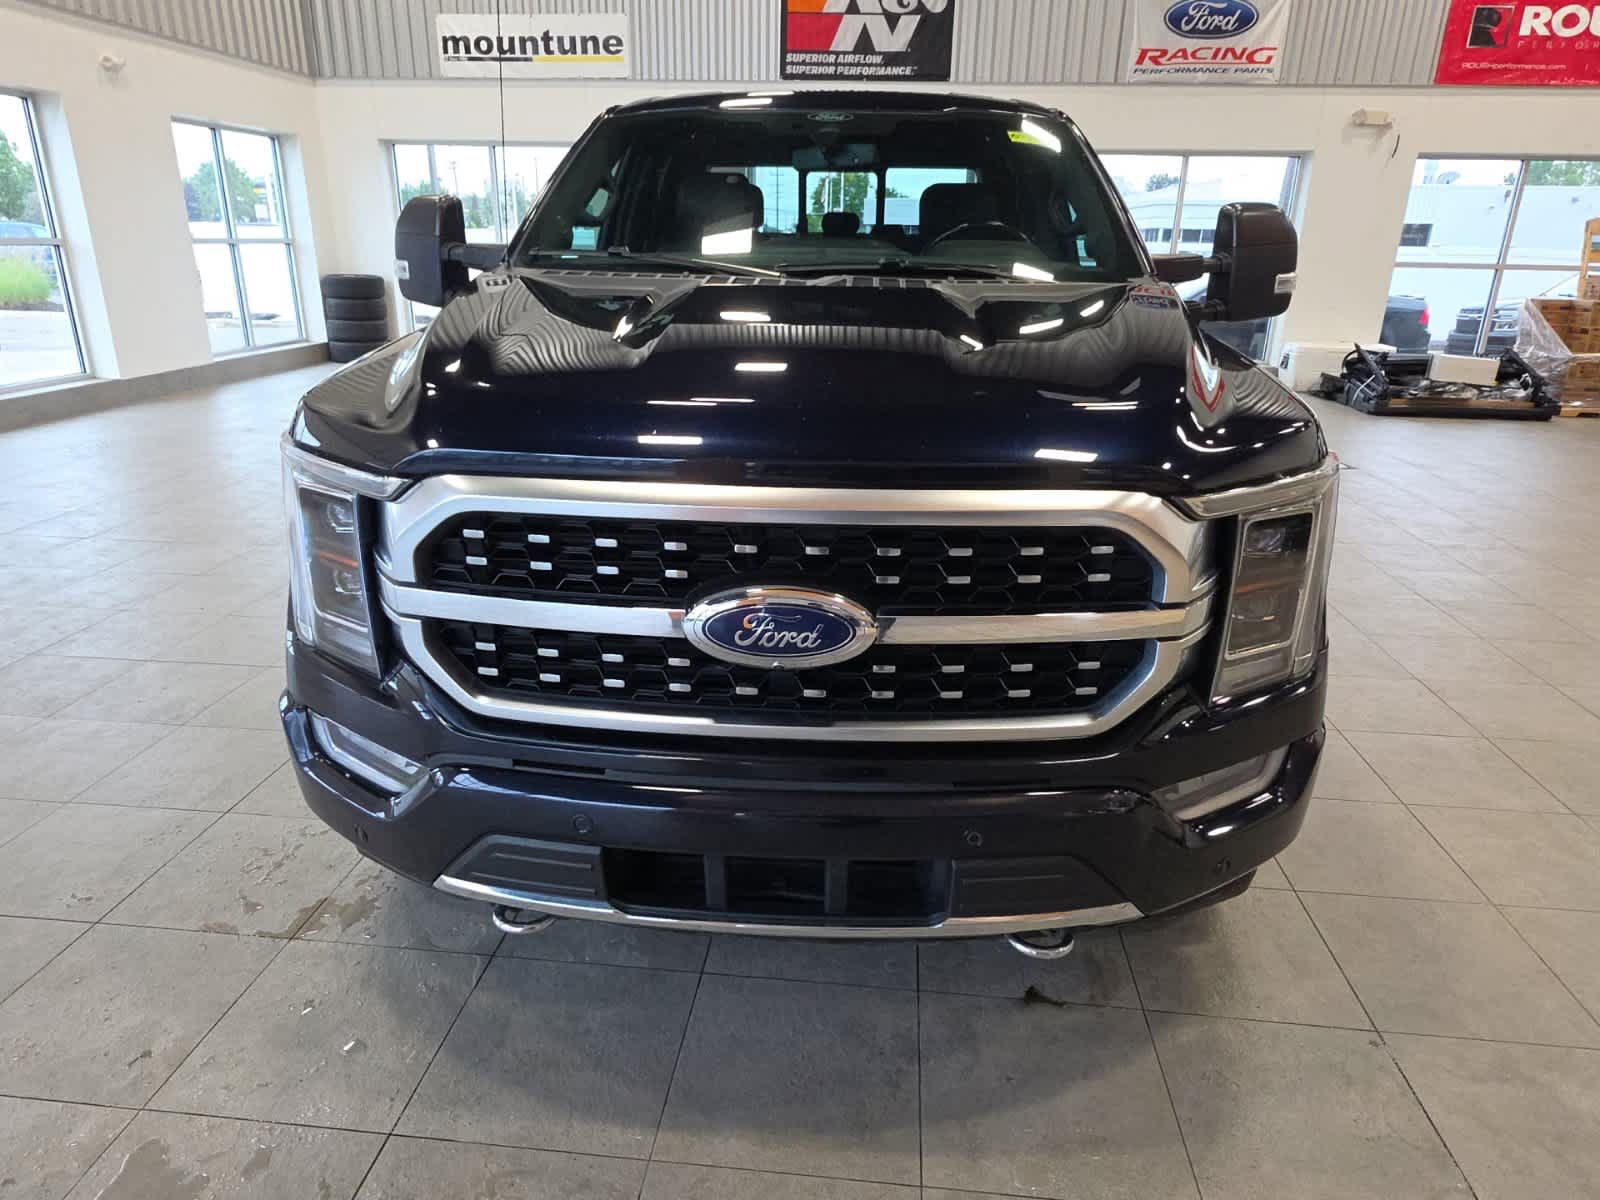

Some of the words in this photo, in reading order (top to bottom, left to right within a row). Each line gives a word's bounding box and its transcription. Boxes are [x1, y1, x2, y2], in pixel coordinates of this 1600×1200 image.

[1181, 2, 1241, 31] Ford
[441, 29, 624, 55] mountune
[786, 53, 835, 63] SUPERIOR
[1135, 47, 1279, 65] RACING
[786, 65, 837, 74] SUPERIOR
[1133, 67, 1229, 75] PERFORMANCE
[734, 610, 824, 648] Ford
